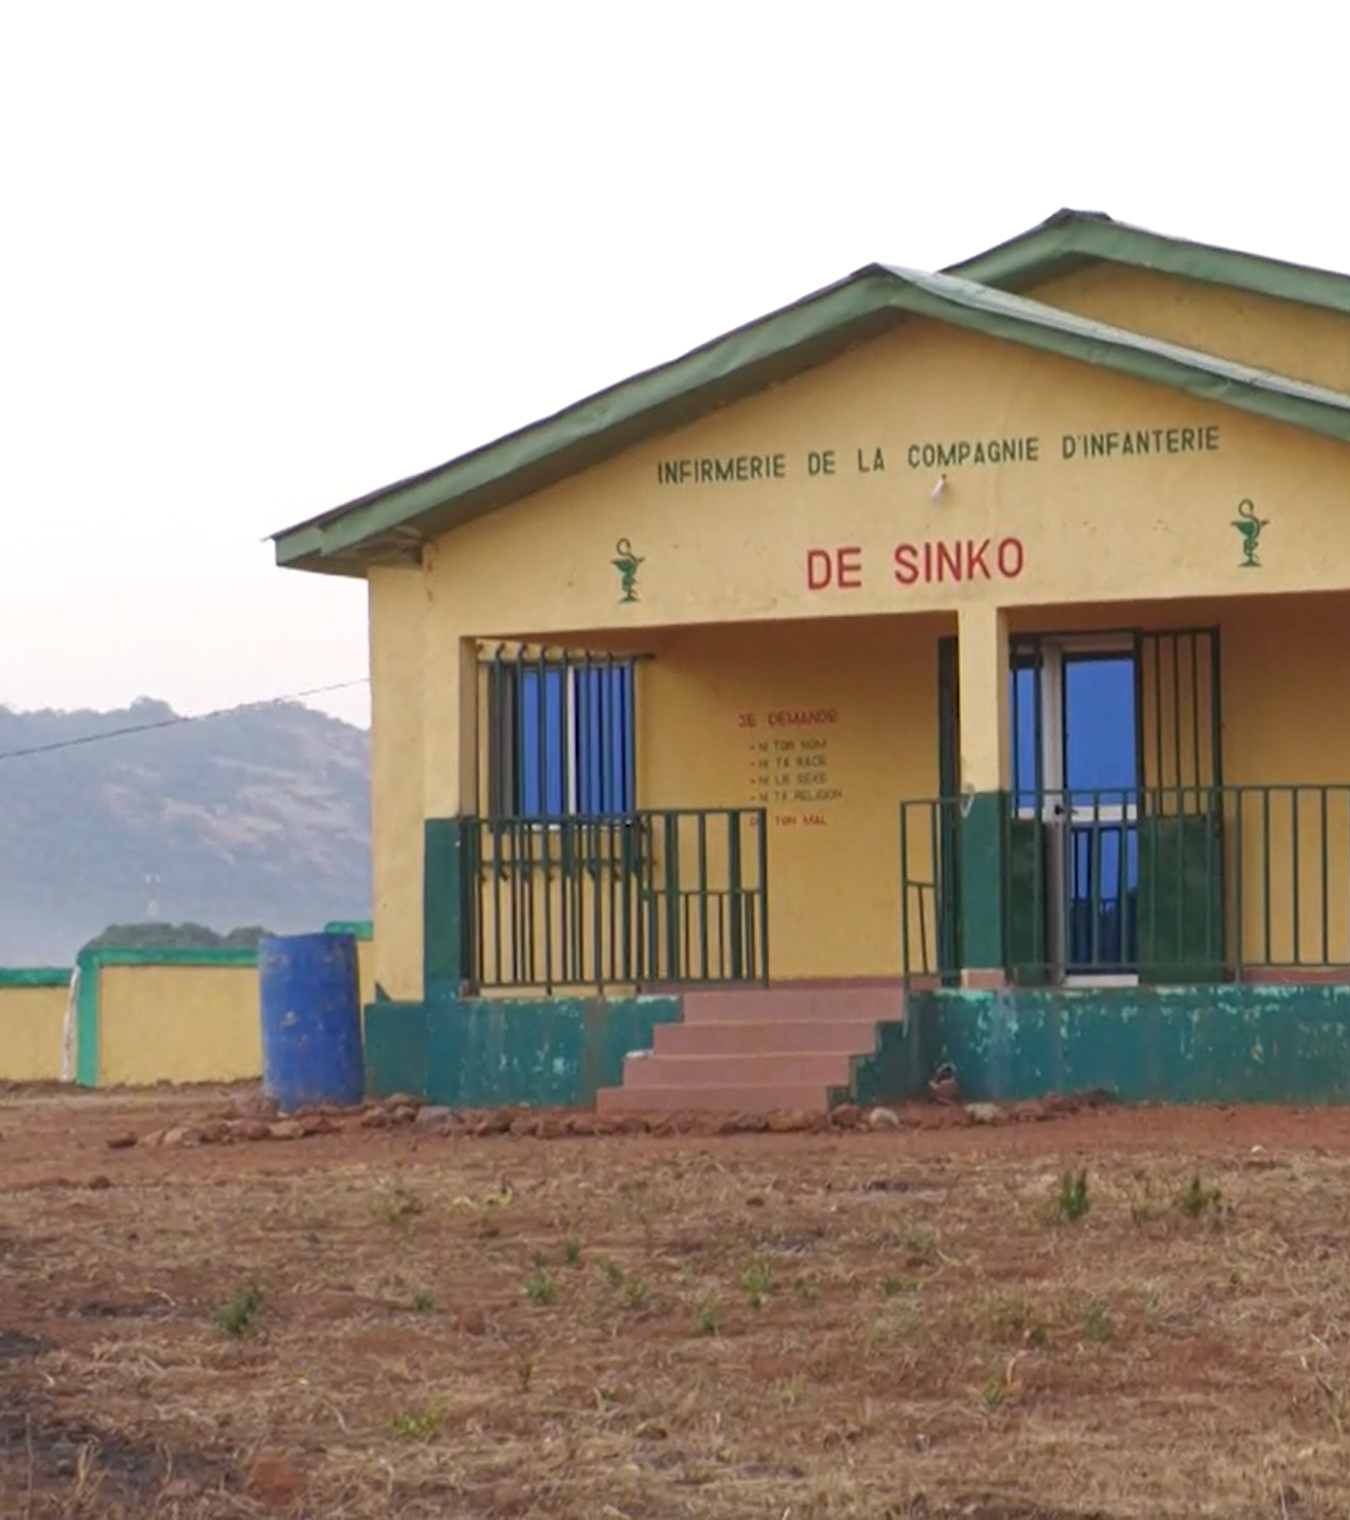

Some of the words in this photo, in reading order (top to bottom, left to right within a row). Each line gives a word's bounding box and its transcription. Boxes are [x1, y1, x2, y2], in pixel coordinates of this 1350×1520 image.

[657, 453, 786, 485] INFIRMERIE
[808, 450, 836, 476] DE
[857, 446, 885, 473] LA
[907, 436, 1039, 469] COMPAGNIE
[1061, 425, 1219, 460] D'INFANTERIE
[807, 546, 862, 591] DE
[894, 536, 1025, 586] SINKO
[738, 713, 757, 728] JE
[768, 708, 838, 726] DEMANDE
